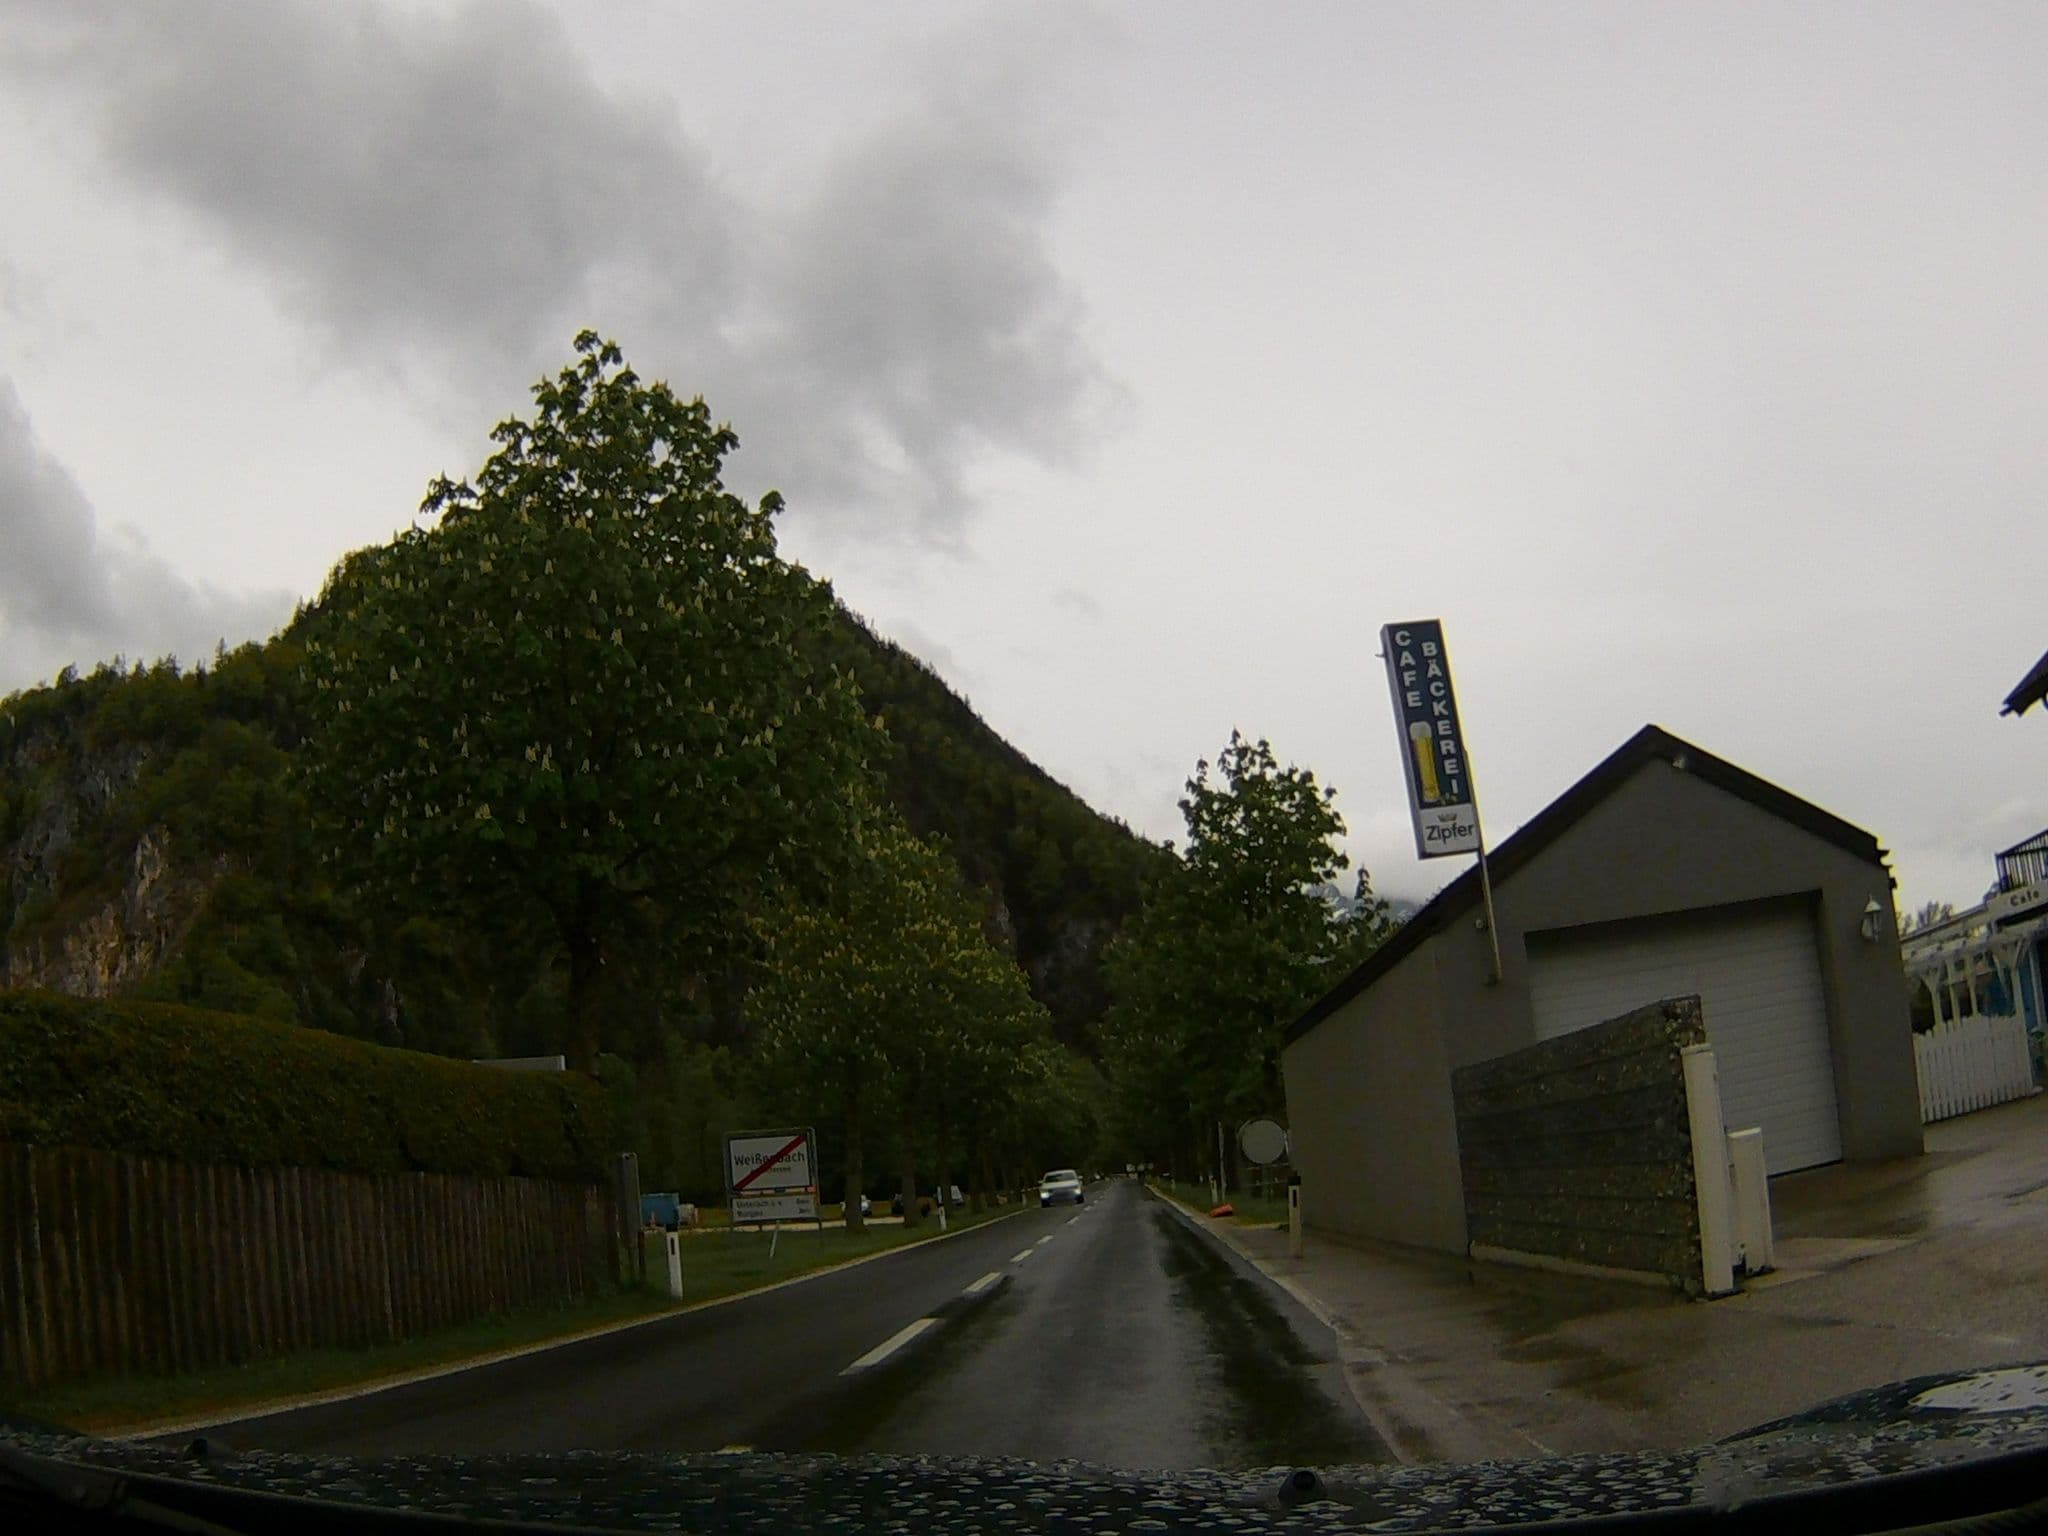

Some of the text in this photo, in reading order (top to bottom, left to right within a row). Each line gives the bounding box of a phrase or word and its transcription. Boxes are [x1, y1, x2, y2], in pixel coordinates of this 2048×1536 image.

[1394, 630, 1422, 708] CAFE
[1422, 641, 1459, 794] BÄCKEREI
[1426, 822, 1475, 844] Zipfer
[734, 1151, 805, 1166] Weißebach
